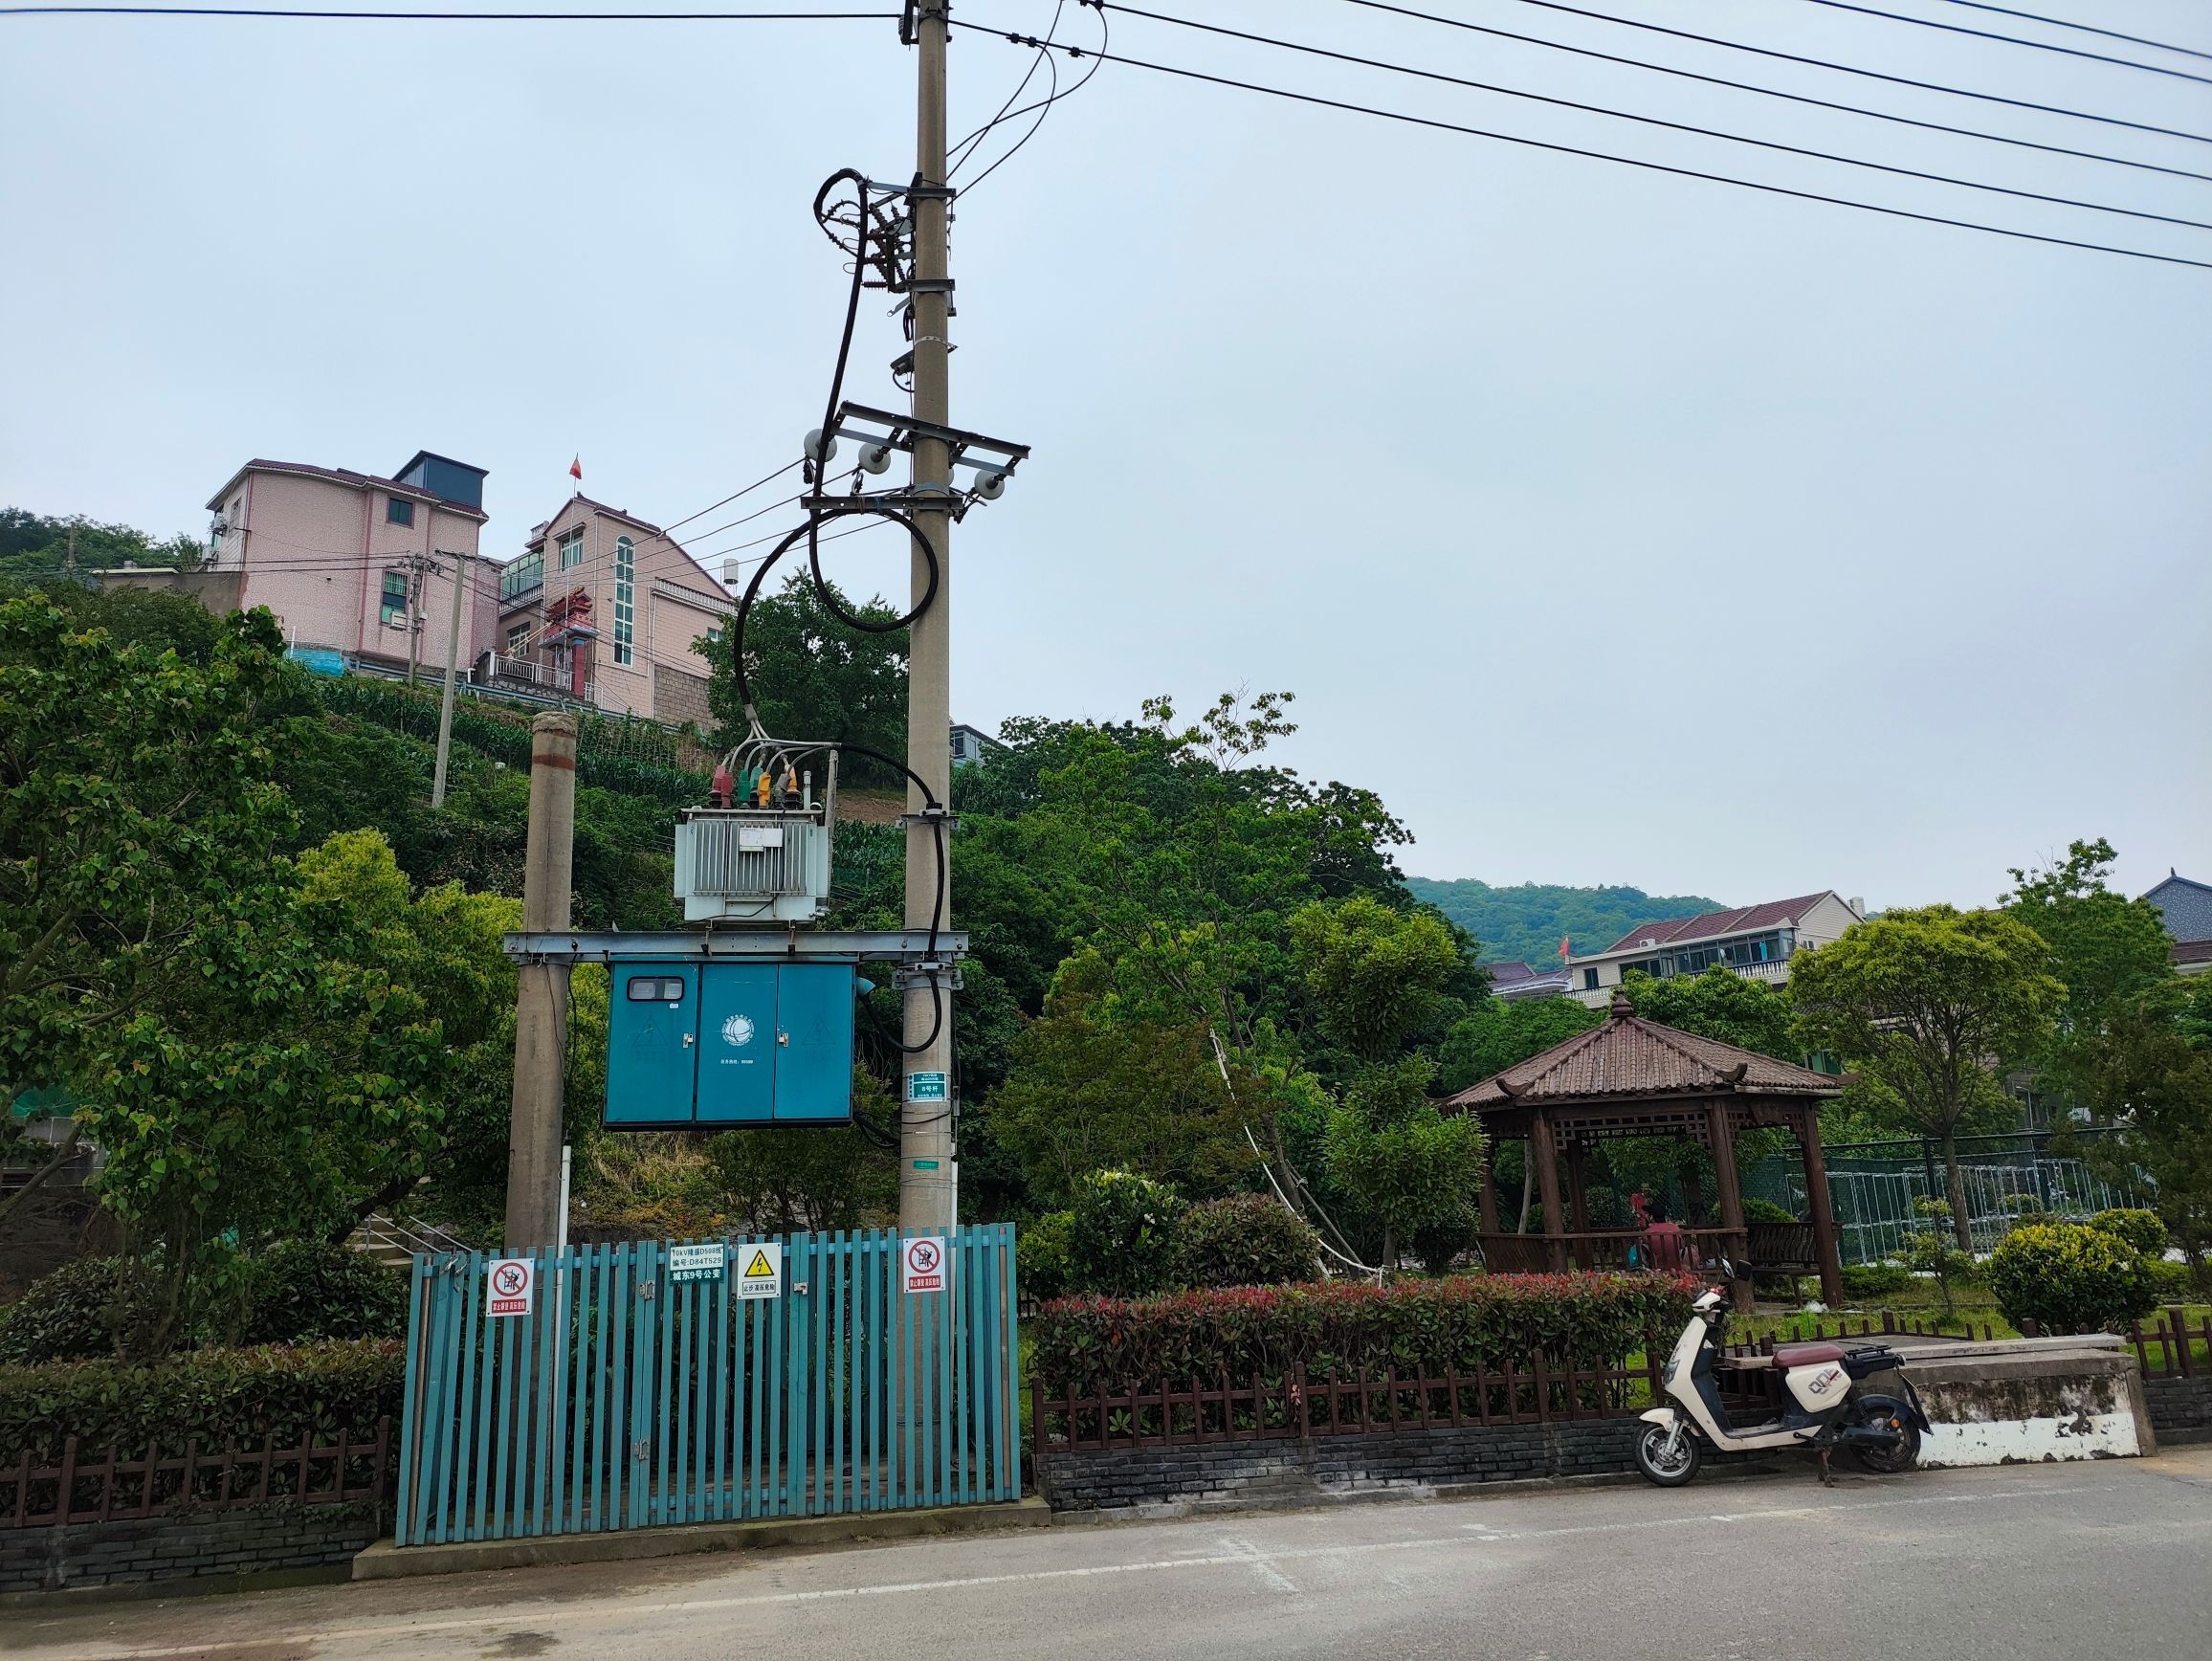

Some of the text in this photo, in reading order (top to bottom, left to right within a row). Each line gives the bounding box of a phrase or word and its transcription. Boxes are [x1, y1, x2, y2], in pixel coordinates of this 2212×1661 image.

[673, 1269, 721, 1281] 城东9号公变
